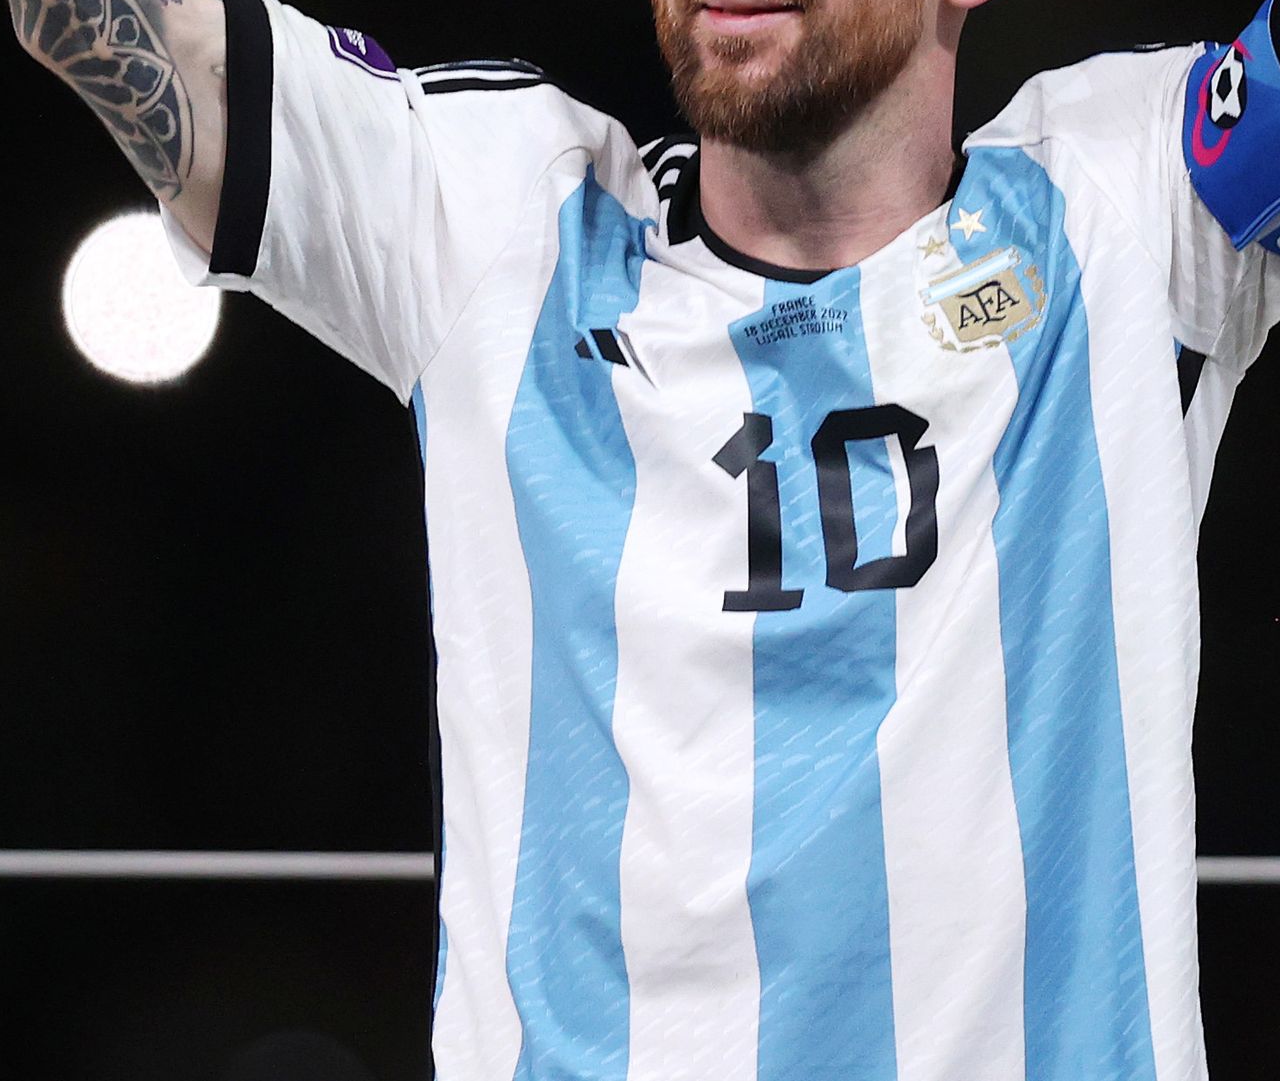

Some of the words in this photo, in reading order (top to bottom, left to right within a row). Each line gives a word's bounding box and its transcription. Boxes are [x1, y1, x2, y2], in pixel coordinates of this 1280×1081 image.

[772, 295, 816, 317] FRANCE
[958, 280, 1020, 331] AFA
[744, 325, 758, 338] 18
[760, 309, 817, 332] DECEMBER
[756, 329, 798, 346] LUSAIL
[799, 321, 843, 336] STADIUM
[712, 403, 940, 612] 10
